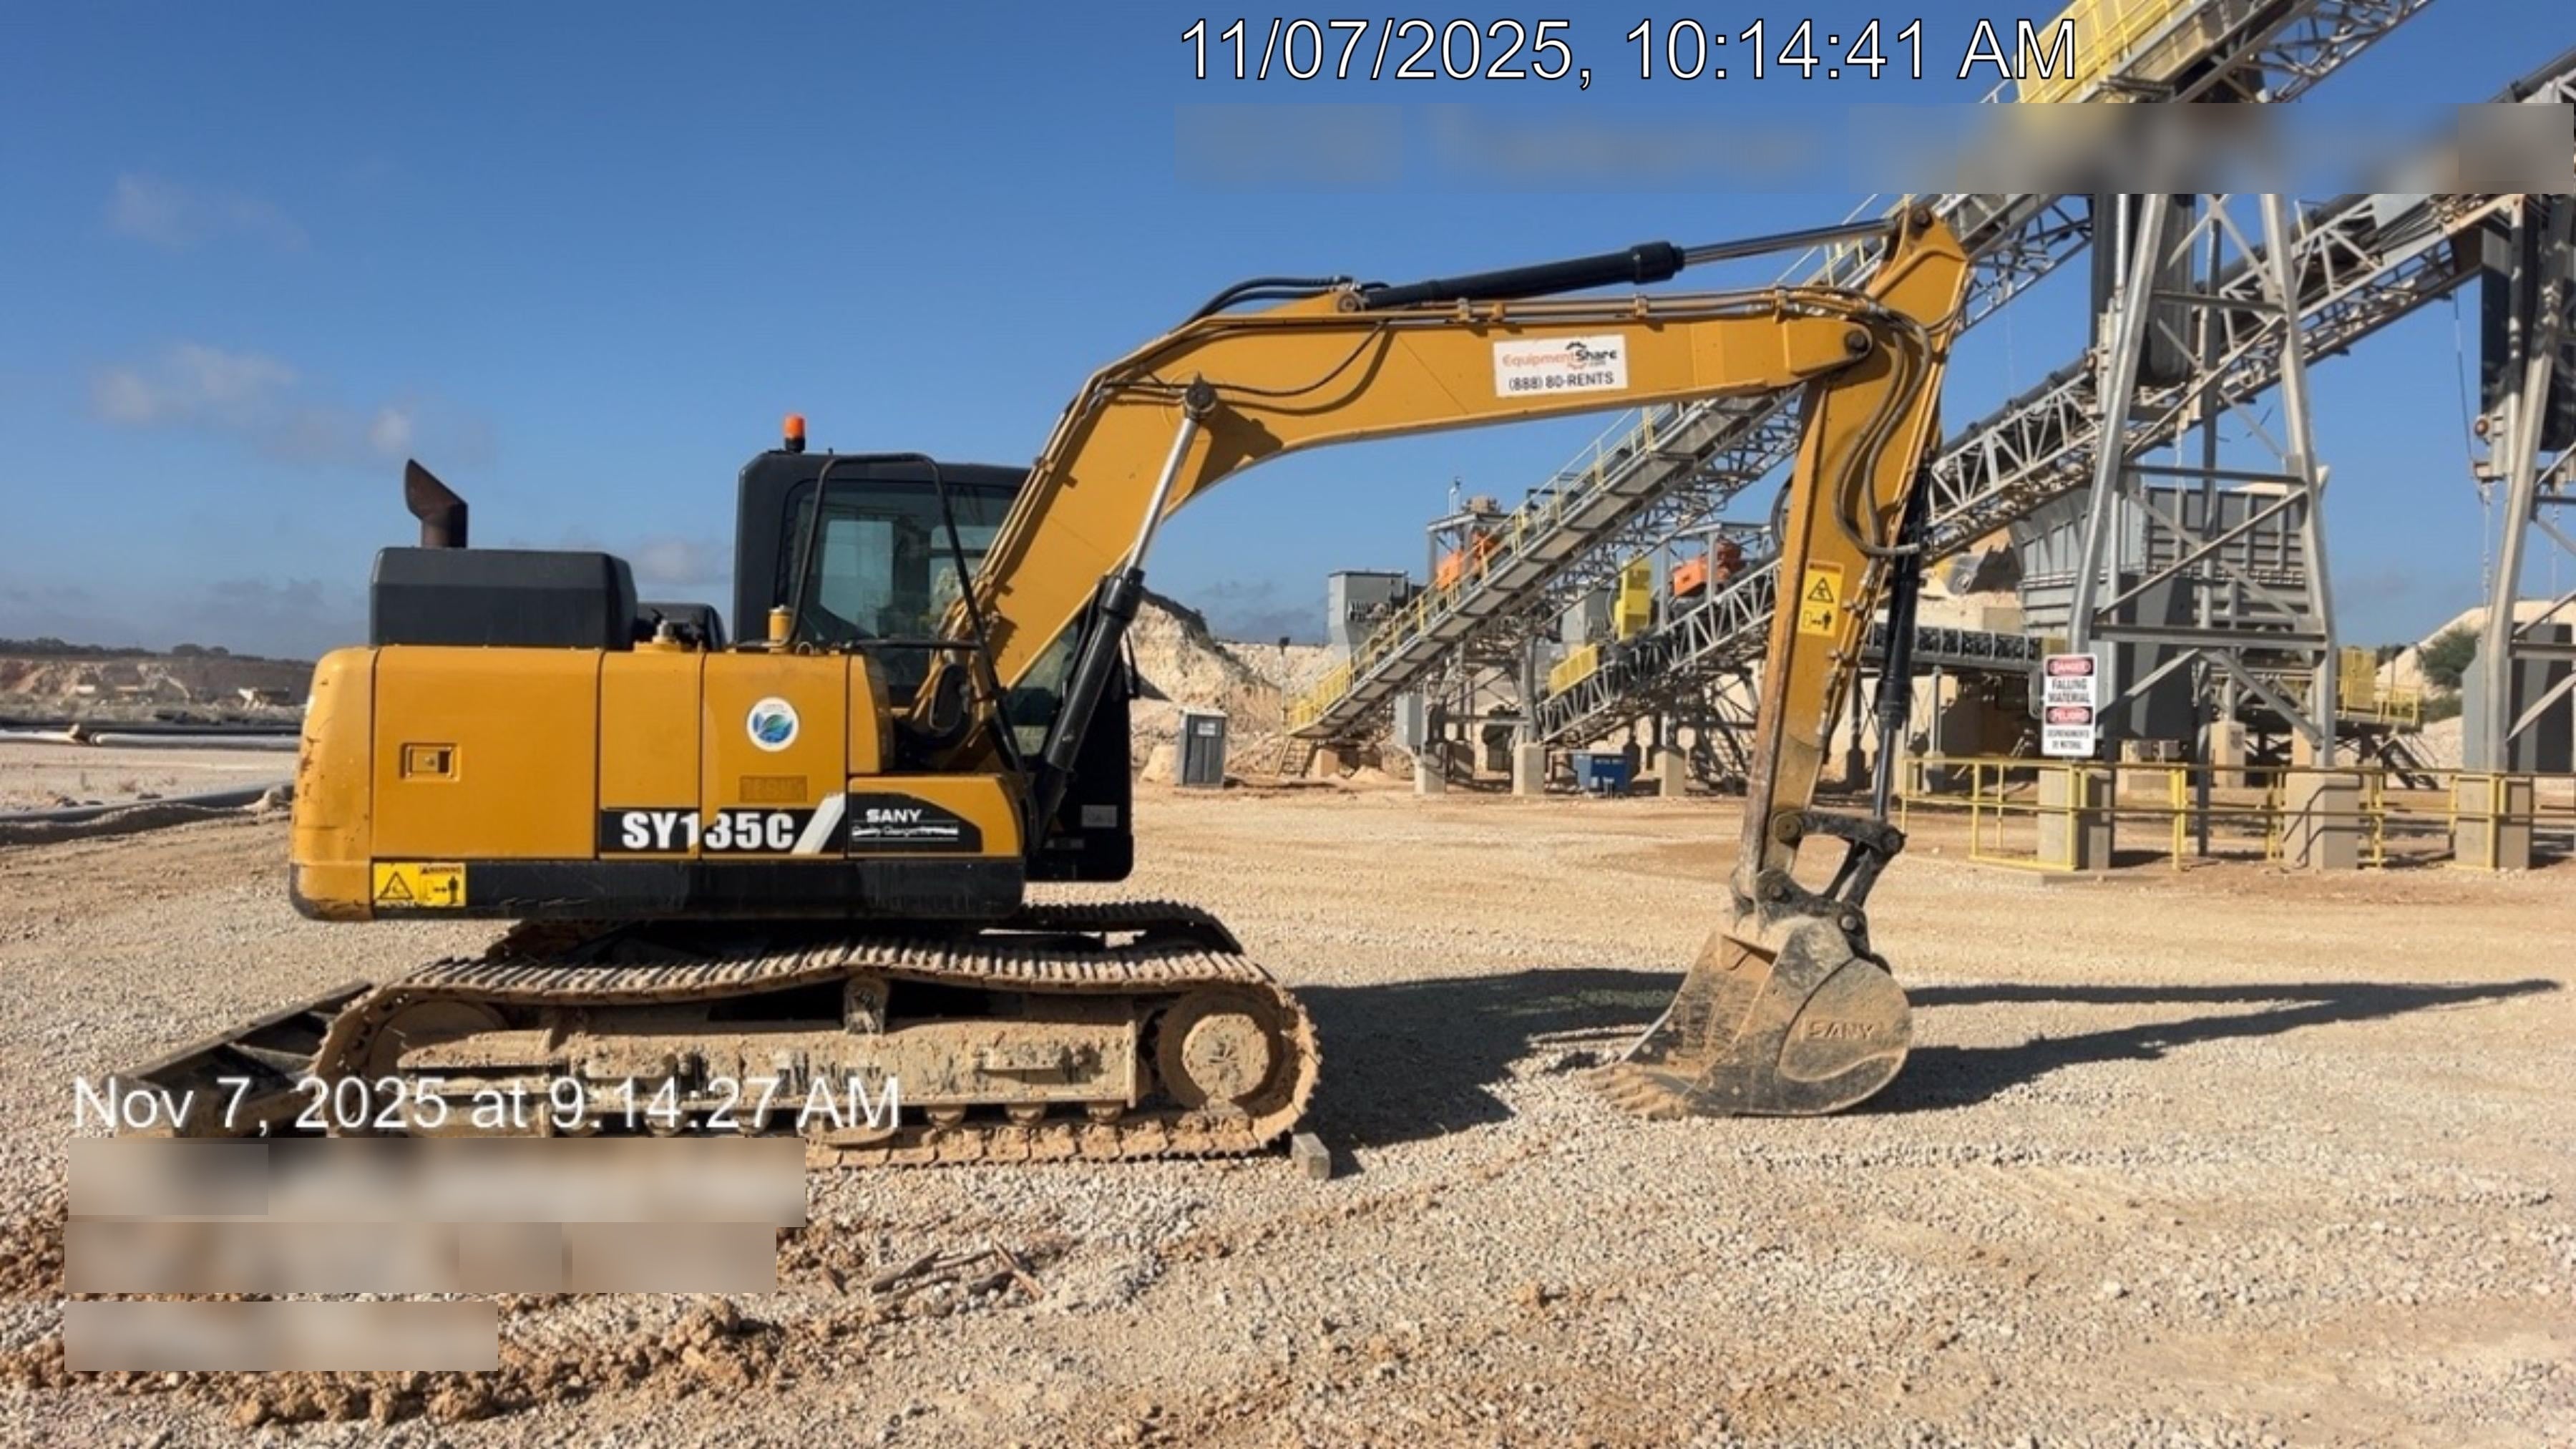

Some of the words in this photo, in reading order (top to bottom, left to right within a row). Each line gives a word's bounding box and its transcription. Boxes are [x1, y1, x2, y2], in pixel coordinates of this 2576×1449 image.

[1508, 376, 1543, 391] (888)
[1546, 370, 1614, 389] 80-RENTS
[2051, 678, 2087, 690] FALLING
[2047, 692, 2090, 703] MATERIAL
[866, 809, 922, 823] SANY
[622, 811, 794, 849] SY135C
[1808, 1021, 1874, 1039] SANY
